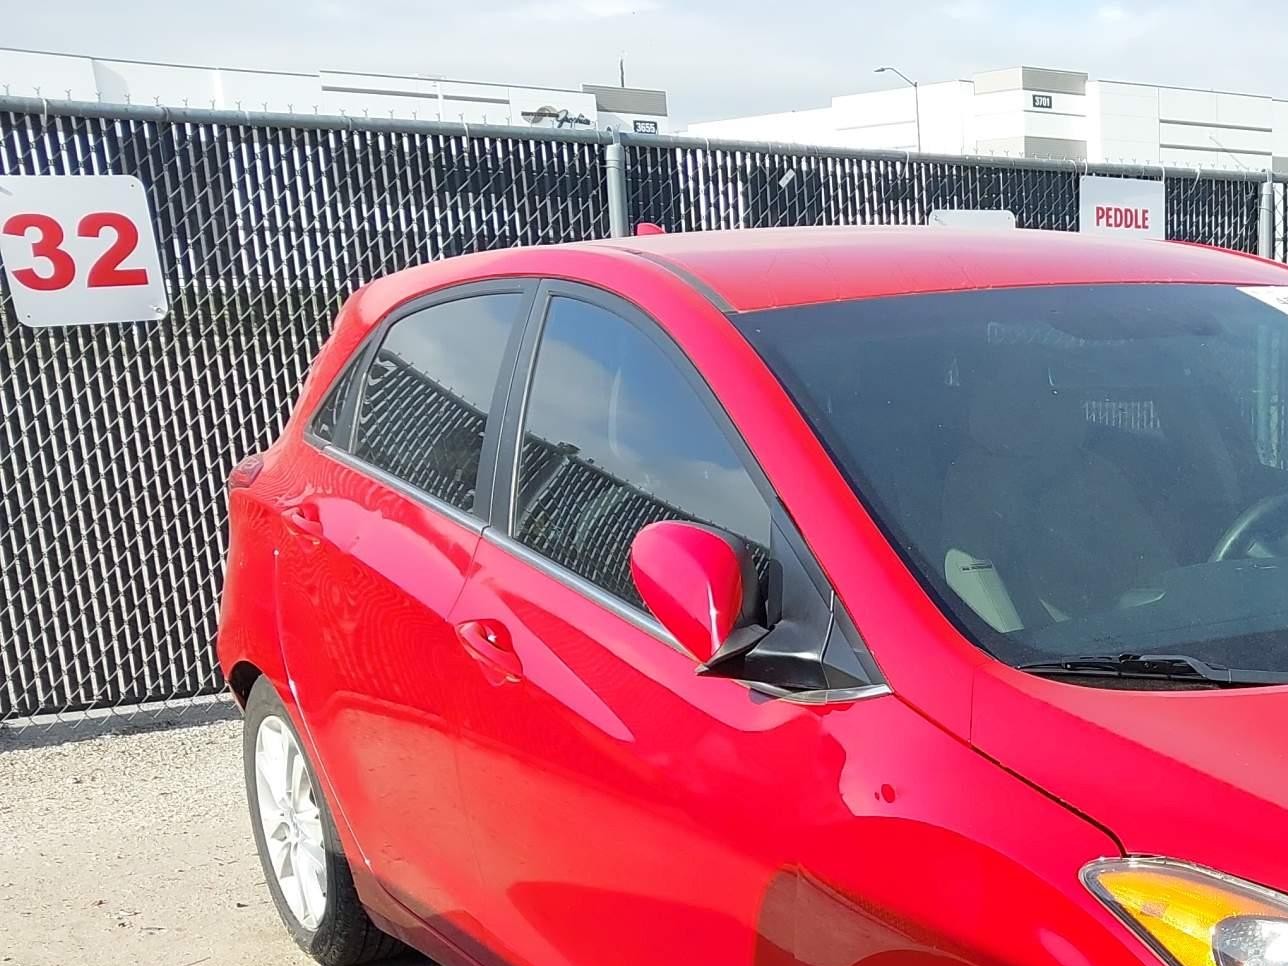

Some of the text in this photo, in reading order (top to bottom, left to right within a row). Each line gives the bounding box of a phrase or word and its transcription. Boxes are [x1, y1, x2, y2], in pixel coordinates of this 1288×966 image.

[1034, 96, 1050, 107] 3701
[635, 122, 656, 133] 3655
[1095, 206, 1149, 229] PEDDLE
[2, 212, 149, 291] 32
